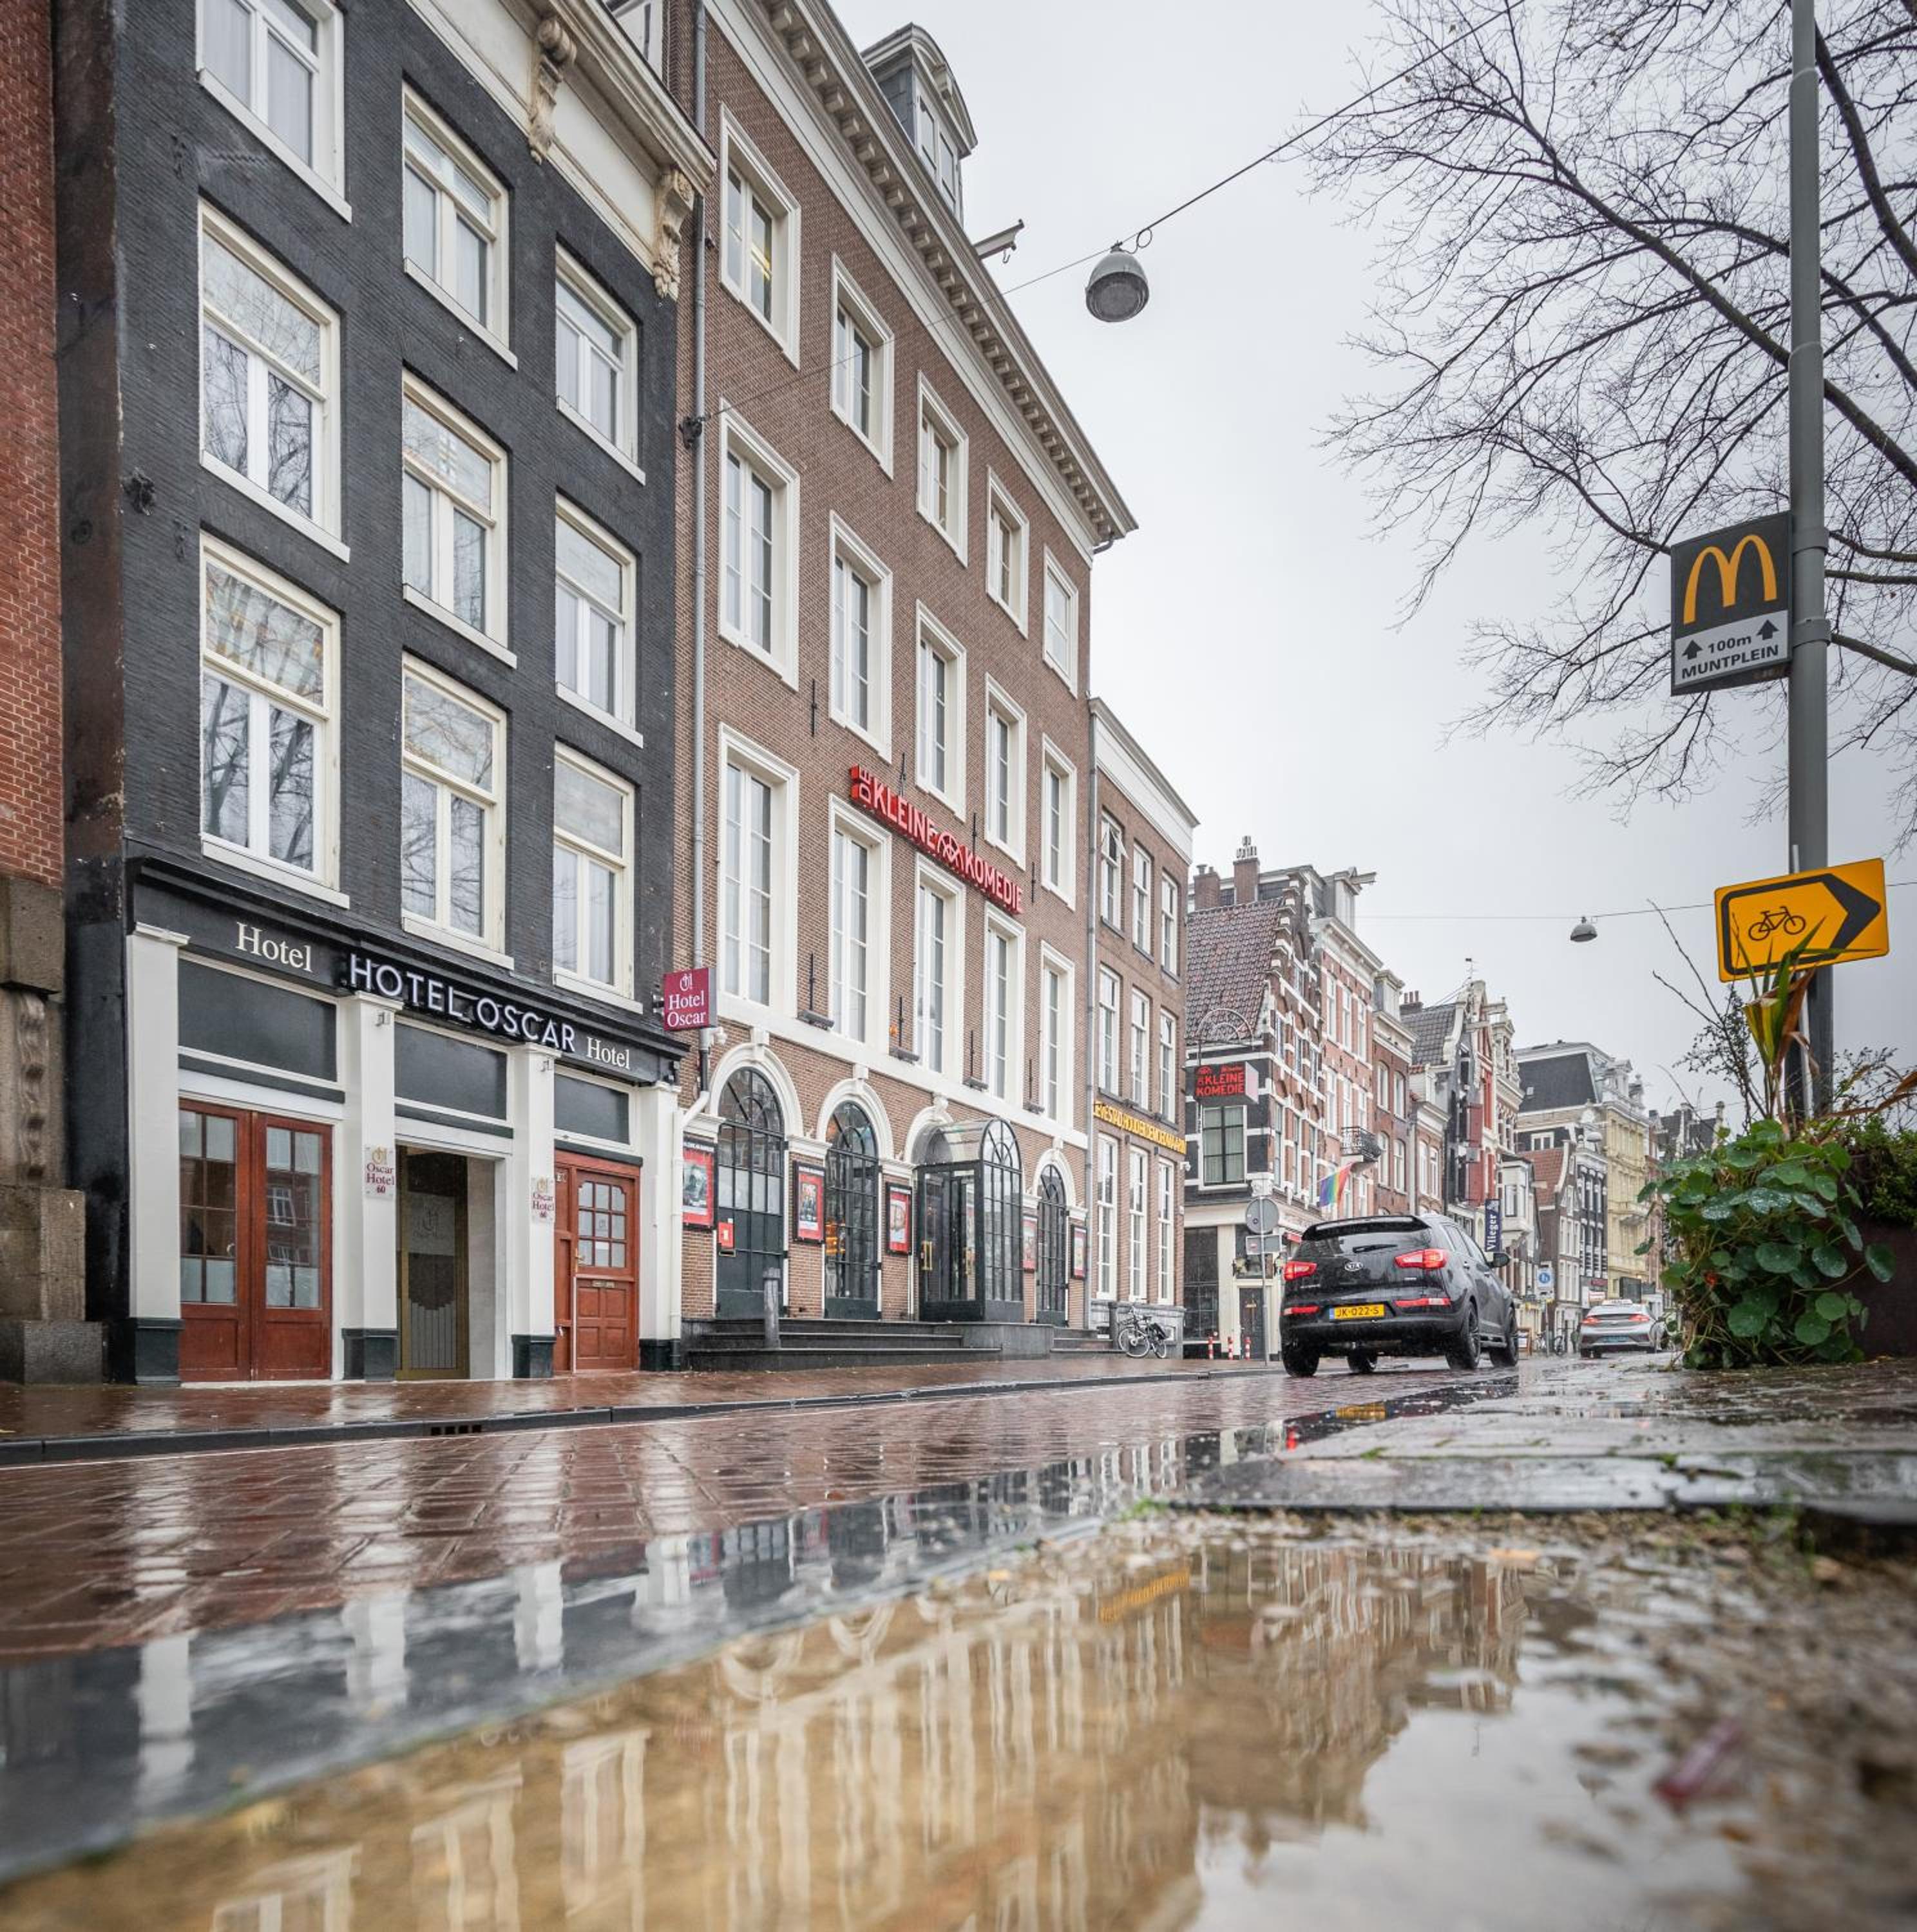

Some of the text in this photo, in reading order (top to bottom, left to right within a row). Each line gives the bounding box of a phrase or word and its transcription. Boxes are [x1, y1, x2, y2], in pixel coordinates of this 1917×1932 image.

[1708, 635, 1751, 654] 100m
[1681, 645, 1779, 679] MUNTPLEIN
[873, 777, 936, 851] KLEINE
[966, 851, 1024, 914] KOMEDIE
[235, 922, 313, 972] Hotel
[350, 953, 576, 1052] HOTEL OSCAR
[669, 990, 705, 1010] Hotel
[667, 1011, 707, 1027] Oscar
[586, 1036, 630, 1070] Hotel
[1205, 1072, 1245, 1086] KLEINE
[1196, 1082, 1245, 1097] KOMEDIE
[367, 1162, 394, 1174] Oscar
[366, 1173, 395, 1186] Hotel
[1486, 1213, 1499, 1250] Vlieger
[1335, 1305, 1380, 1318] JK-022-S
